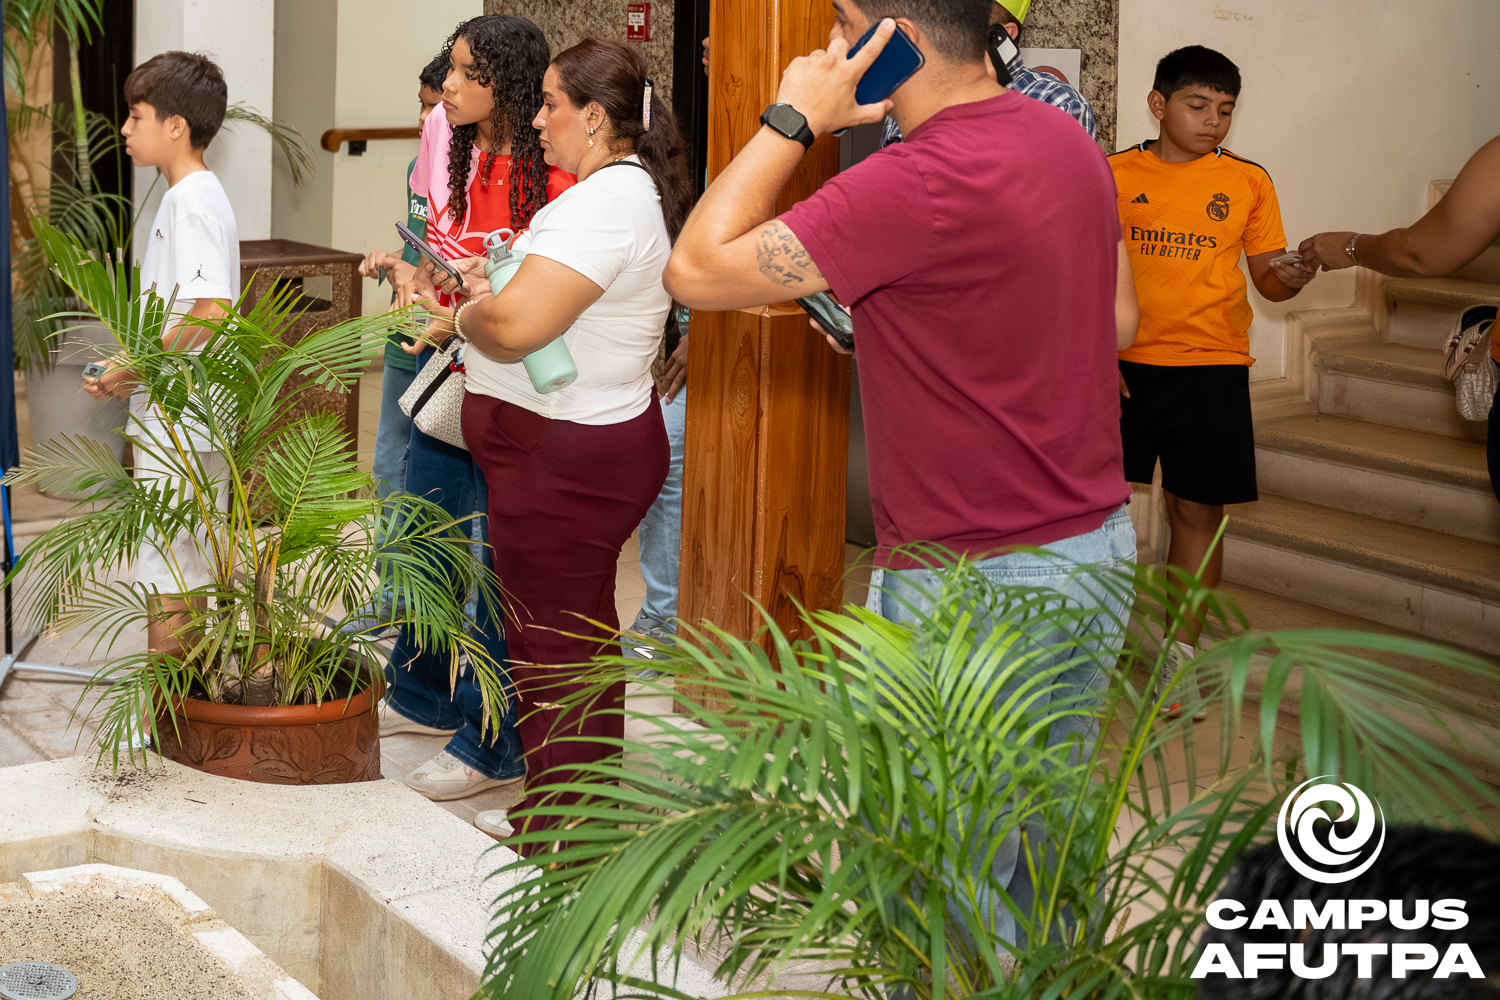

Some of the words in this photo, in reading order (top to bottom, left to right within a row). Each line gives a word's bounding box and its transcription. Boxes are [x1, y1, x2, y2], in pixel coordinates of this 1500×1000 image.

[1130, 226, 1217, 249] Emirates
[1140, 243, 1158, 256] FLY
[1159, 245, 1201, 261] BETTER
